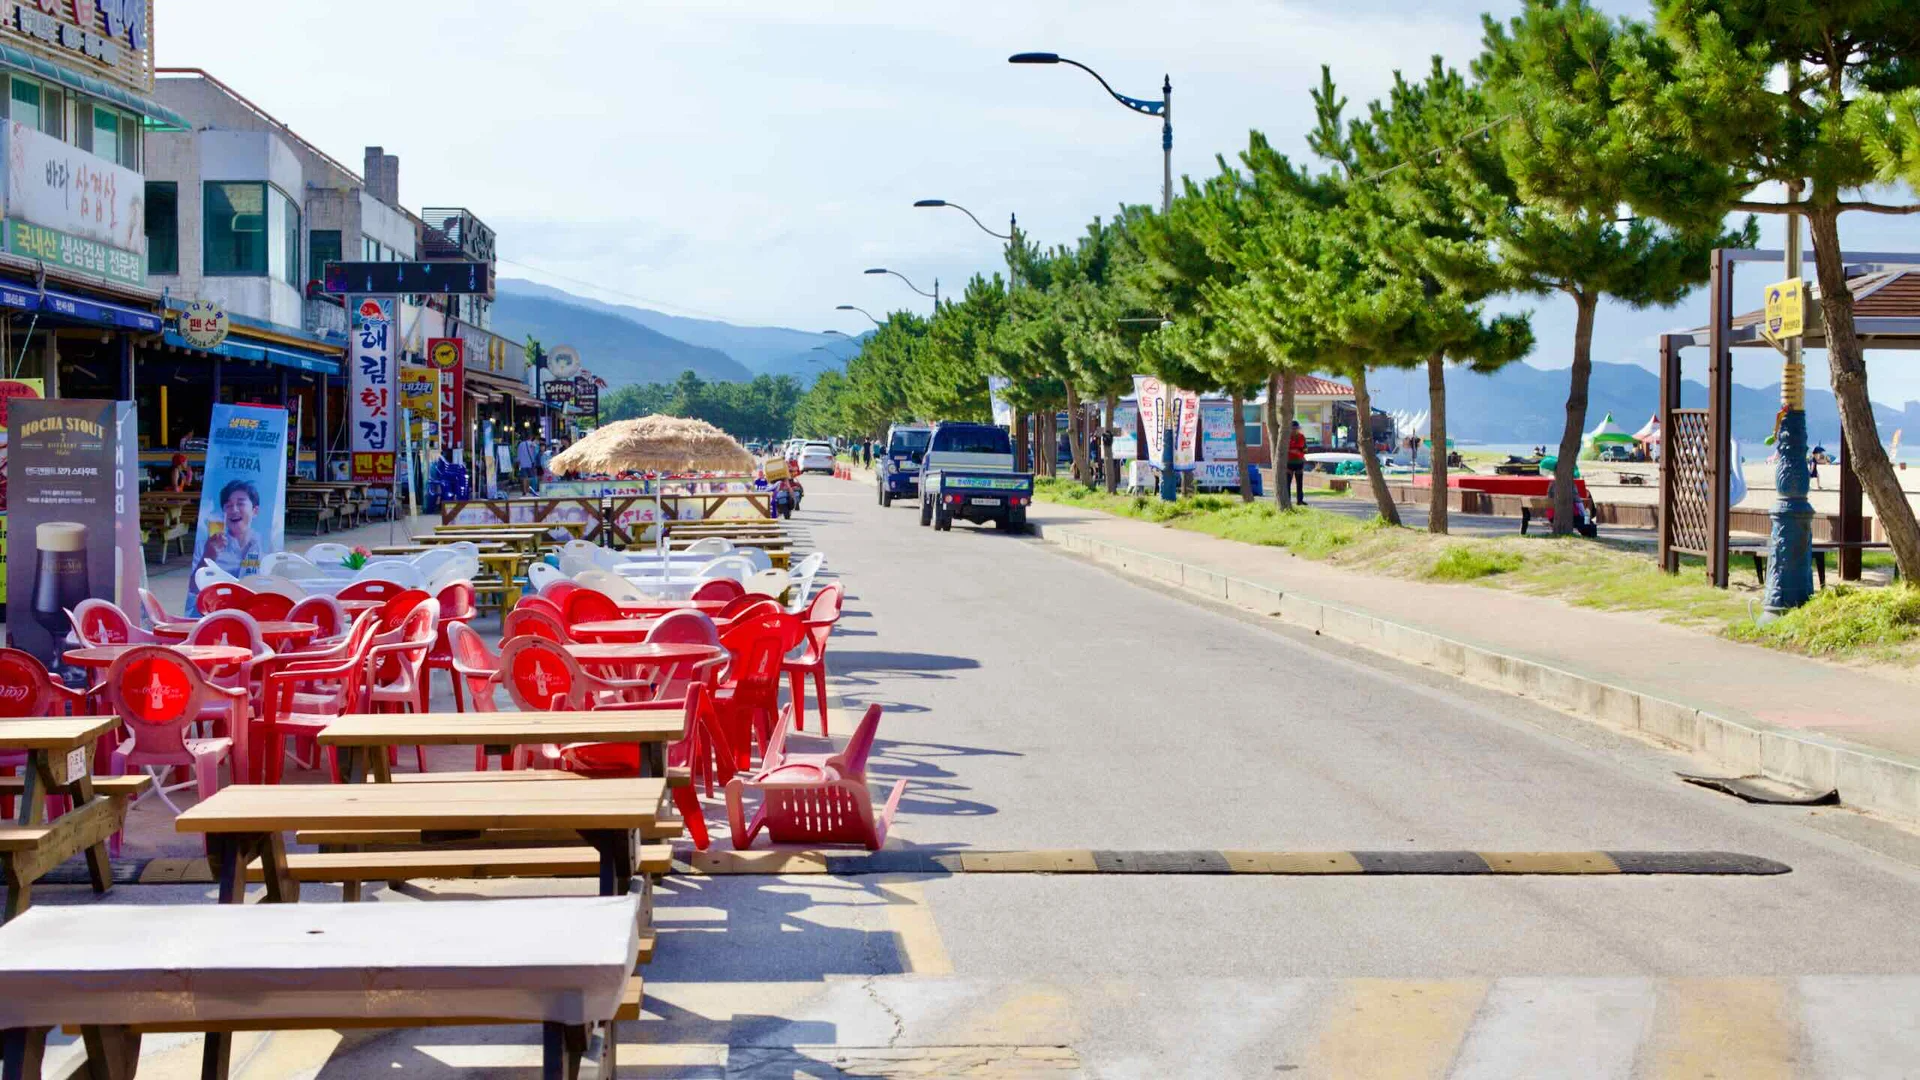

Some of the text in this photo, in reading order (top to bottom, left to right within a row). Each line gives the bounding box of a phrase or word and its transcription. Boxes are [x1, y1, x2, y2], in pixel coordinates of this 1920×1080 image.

[46, 158, 117, 229] 바다 삼겹살
[16, 223, 57, 260] 국내산
[60, 235, 106, 272] 생삼겹살
[109, 251, 140, 282] 전문점
[190, 318, 217, 332] 펜션
[359, 323, 388, 449] 해림횟집
[21, 415, 106, 439] MOCHA STOUT
[224, 456, 261, 472] TERRA
[354, 453, 394, 474] 펜션
